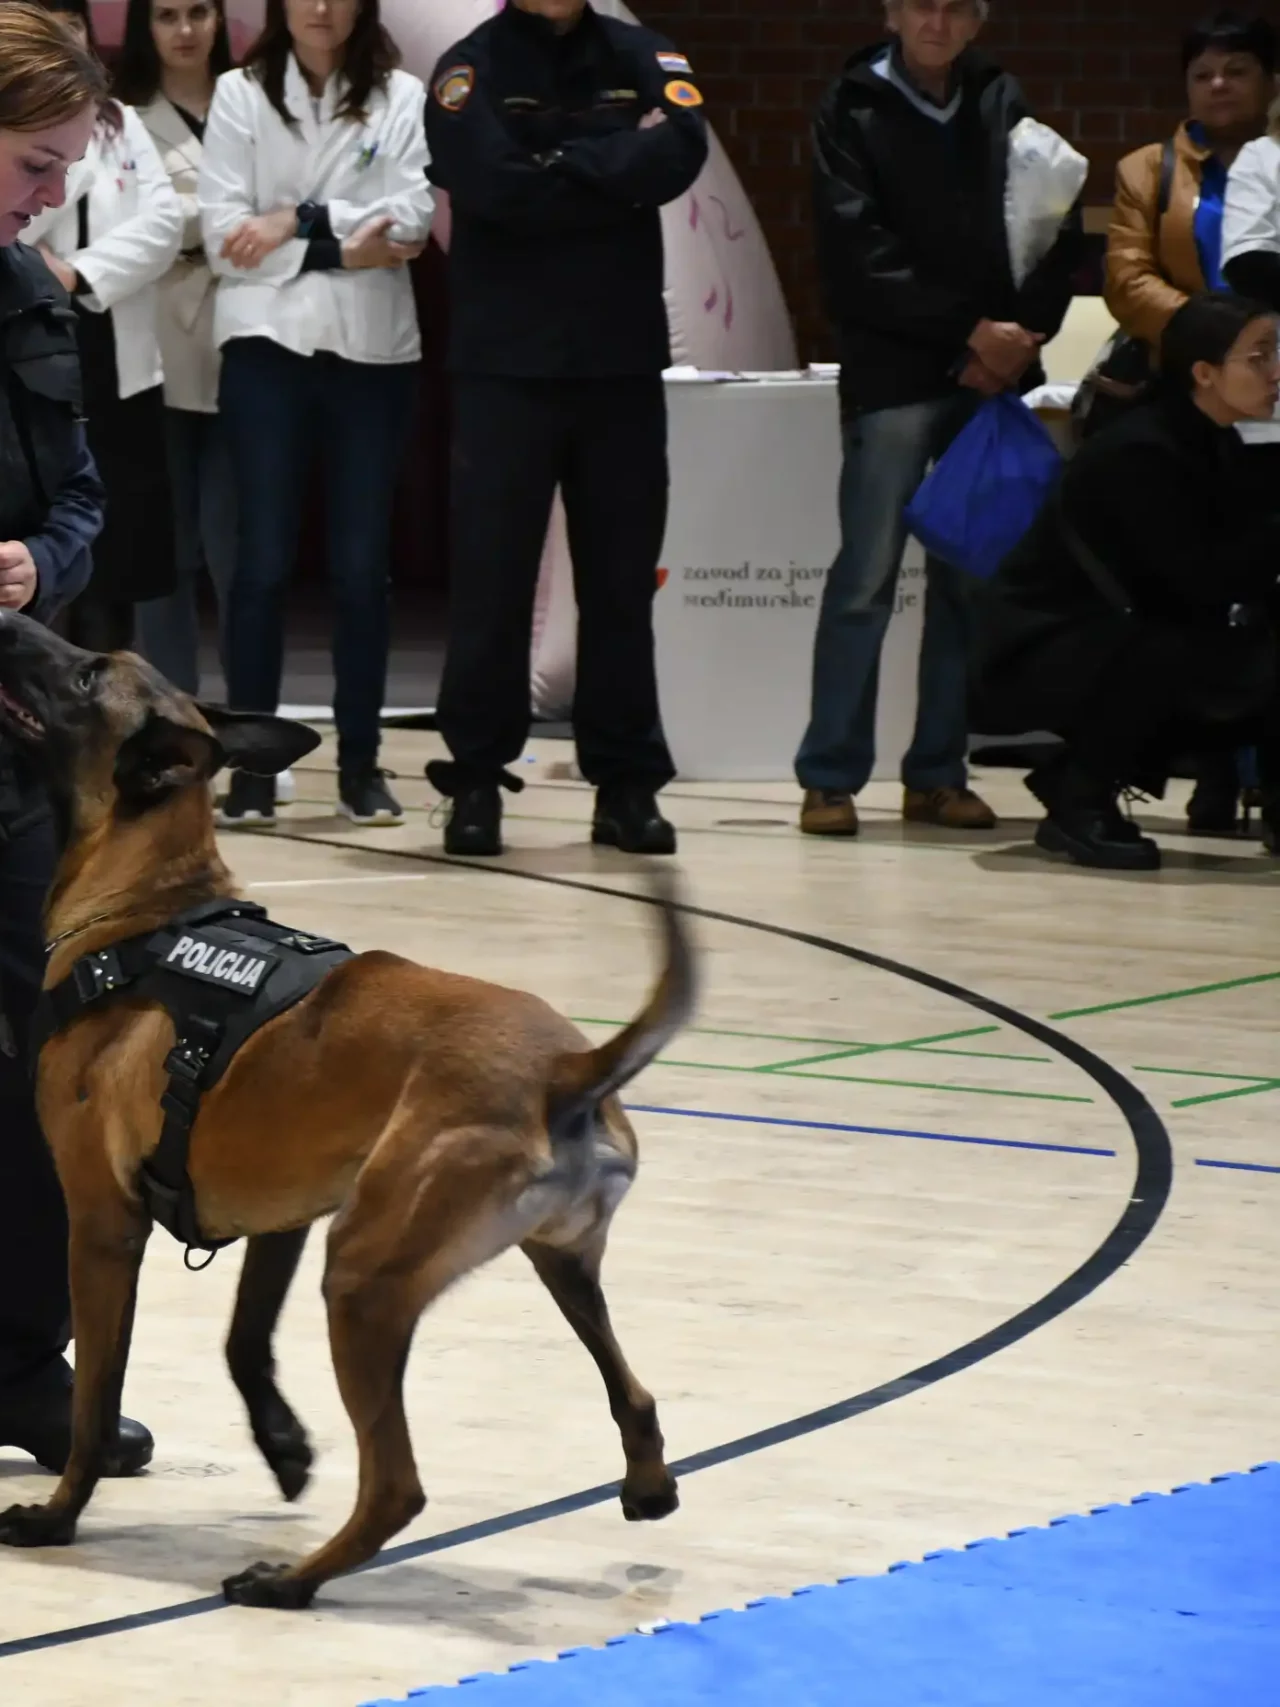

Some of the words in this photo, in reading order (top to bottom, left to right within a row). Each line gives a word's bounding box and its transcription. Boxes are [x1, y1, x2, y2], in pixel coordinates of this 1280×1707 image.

[683, 561, 750, 581] zavod
[755, 567, 783, 581] za
[167, 935, 267, 988] POLICIJA
